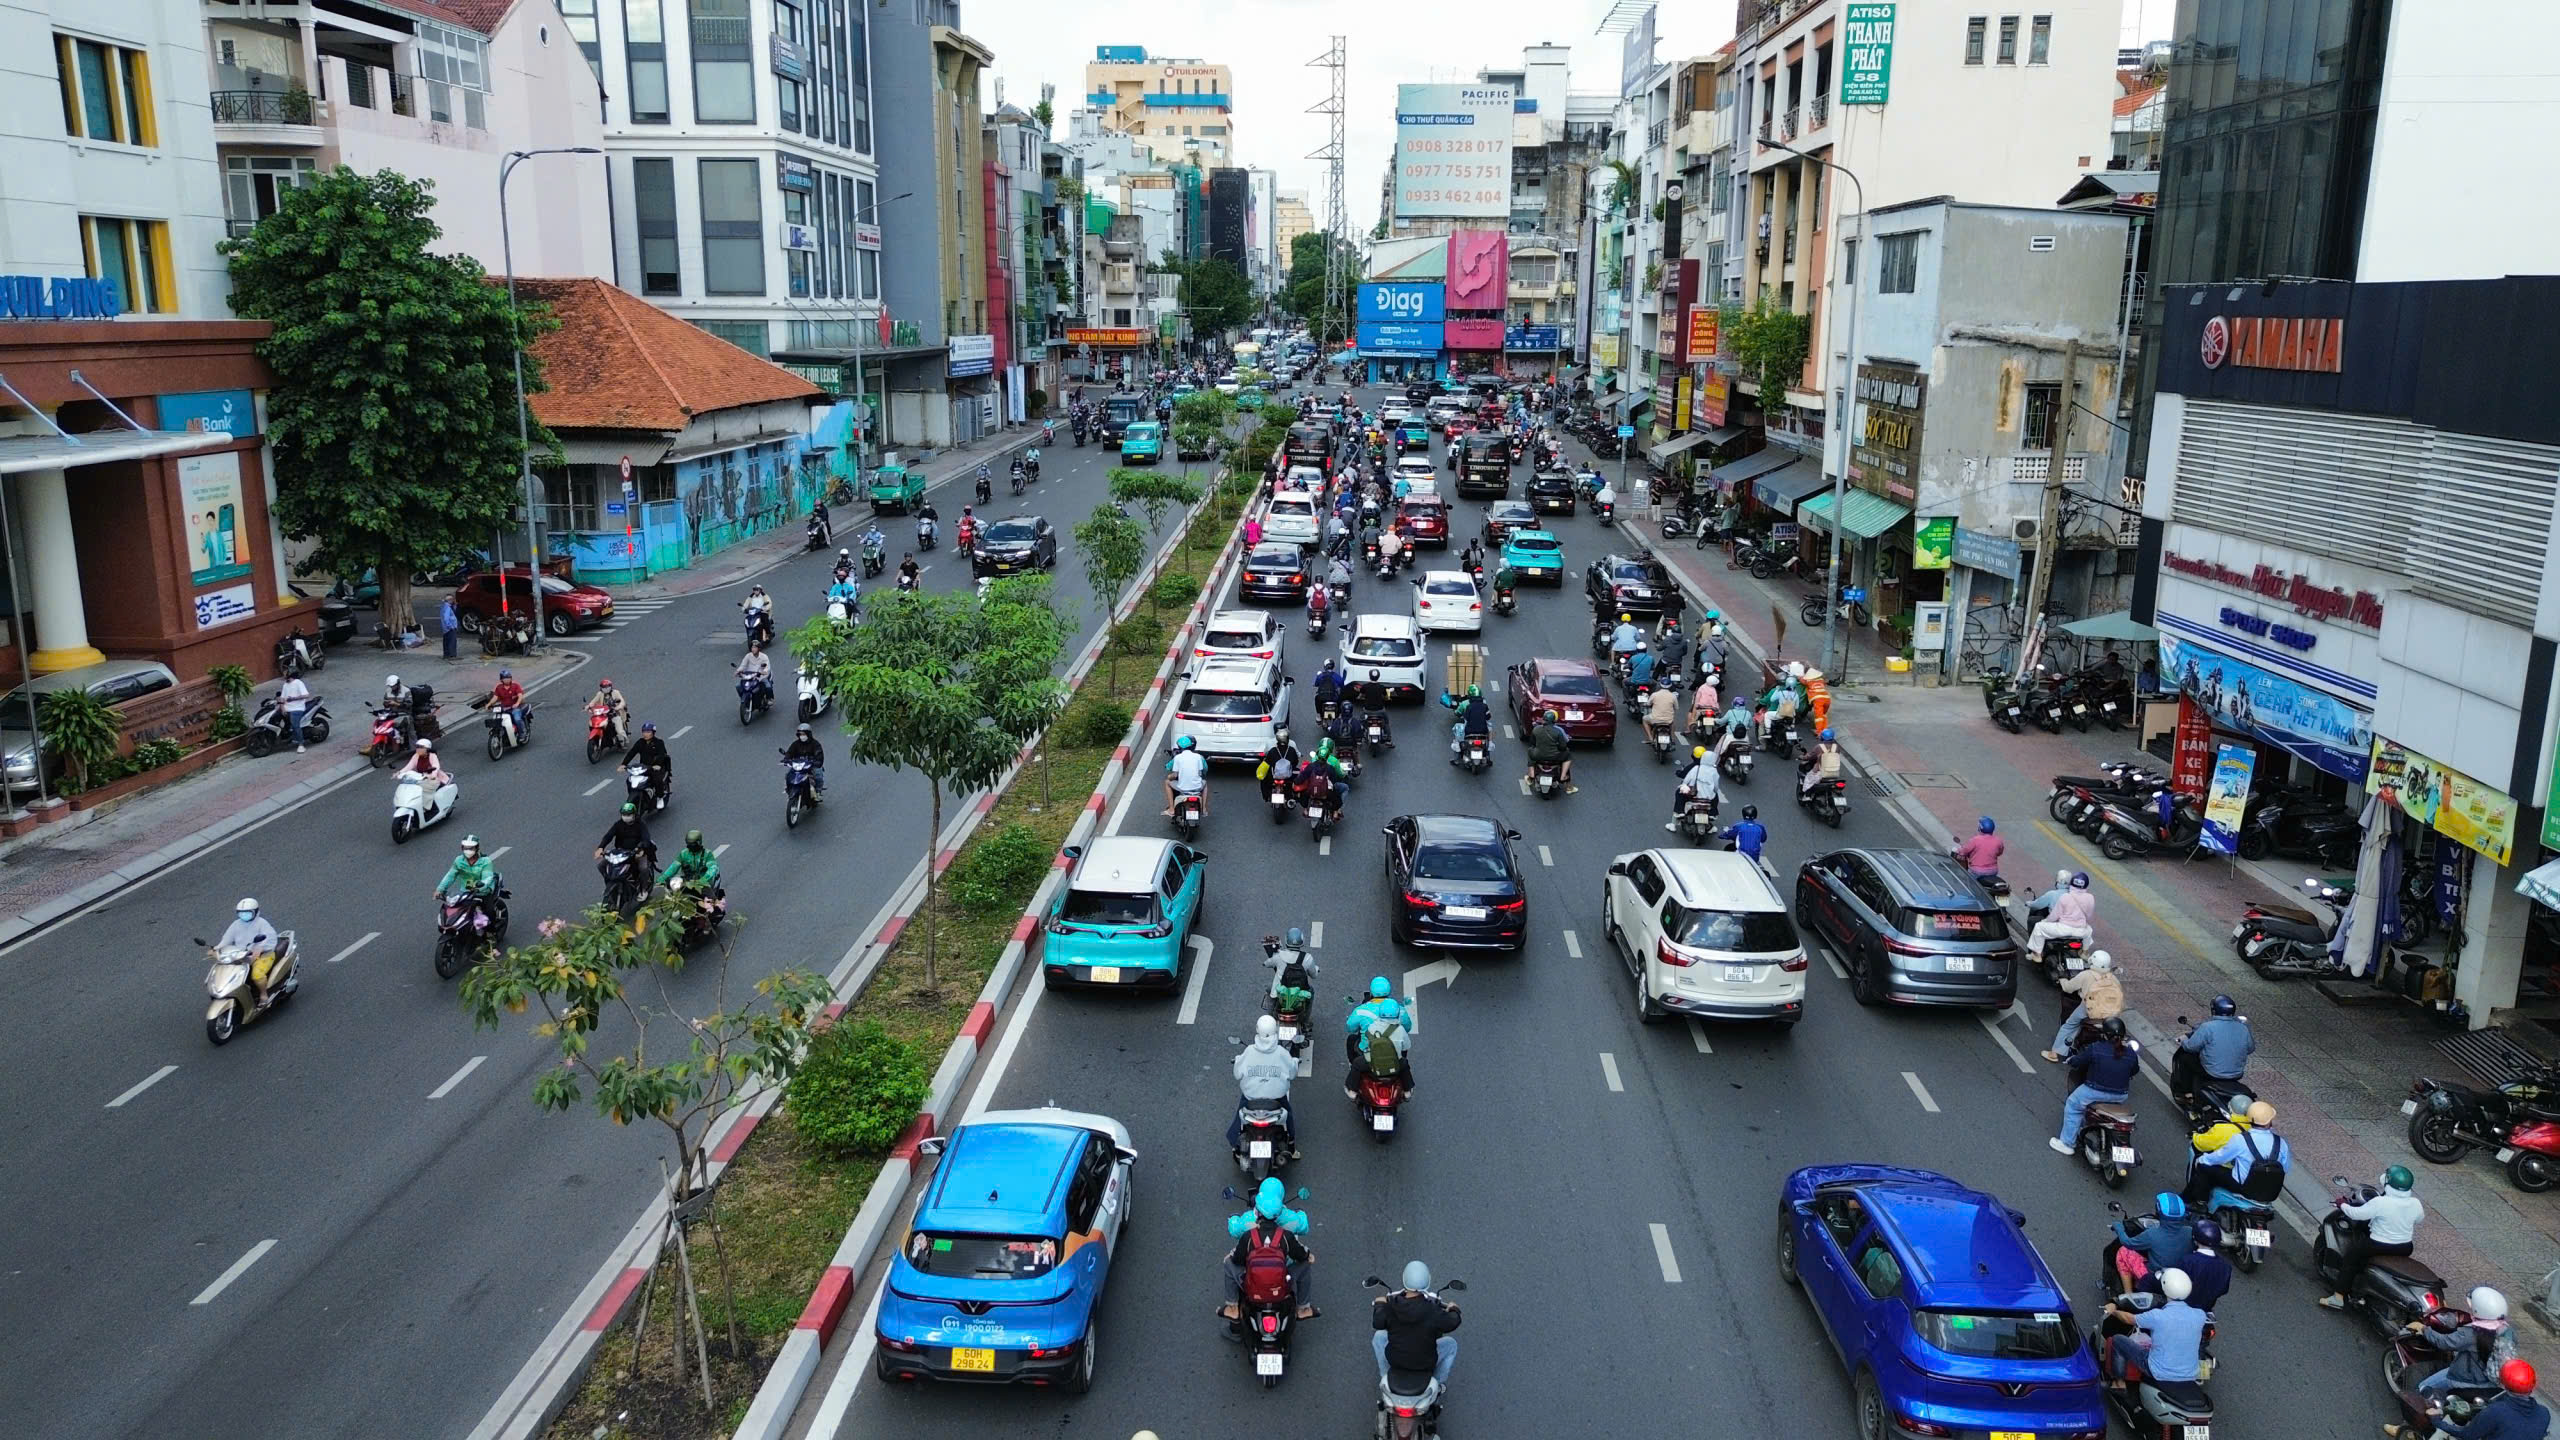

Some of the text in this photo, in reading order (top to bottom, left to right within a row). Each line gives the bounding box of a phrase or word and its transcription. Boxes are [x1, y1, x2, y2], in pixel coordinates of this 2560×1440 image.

[1851, 5, 1891, 18] ATISÔ
[1848, 22, 1893, 48] THẠNH
[1850, 43, 1885, 70] PHÁT
[1462, 90, 1509, 98] PACIFIC
[1417, 115, 1434, 123] THUÊ
[1407, 141, 1504, 152] 0908 328 017
[1406, 165, 1502, 178] 0977 755 751
[1405, 190, 1502, 203] 0933 462 404
[1081, 331, 1098, 341] TÂM
[1117, 331, 1136, 341] KÍNH
[2231, 317, 2344, 373] YAMAHA
[807, 367, 819, 382] FOR
[820, 367, 839, 383] LEASE
[2220, 606, 2317, 652] SPORT SHOP
[2181, 737, 2208, 752] BÁN
[2185, 757, 2201, 768] XE
[2179, 772, 2204, 787] TRẢ
[945, 1320, 960, 1328] 911
[964, 1324, 1004, 1332] 1900 0122
[964, 1349, 983, 1358] 60H
